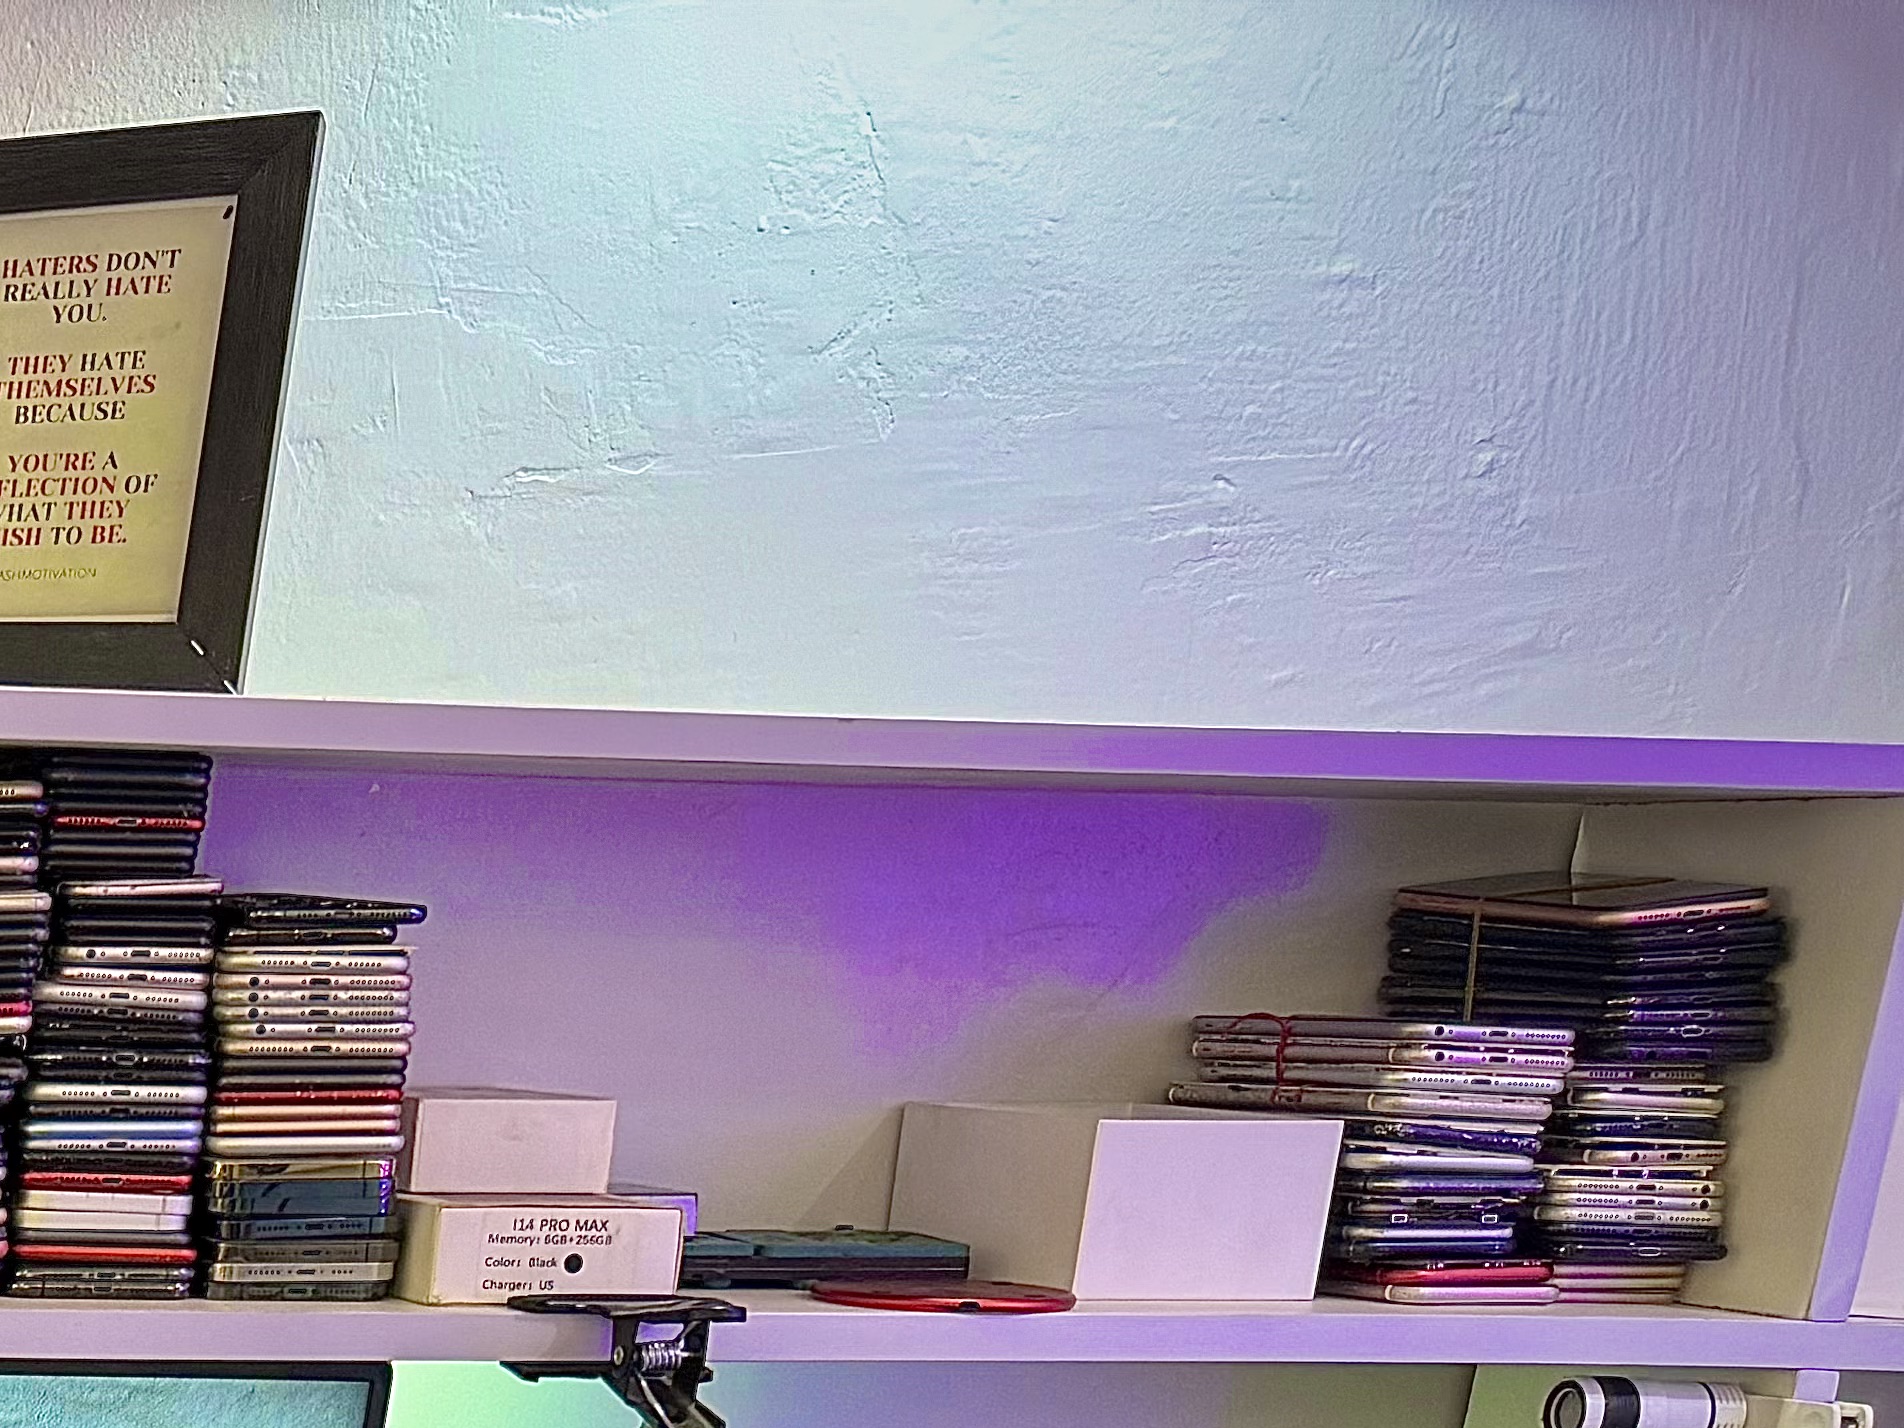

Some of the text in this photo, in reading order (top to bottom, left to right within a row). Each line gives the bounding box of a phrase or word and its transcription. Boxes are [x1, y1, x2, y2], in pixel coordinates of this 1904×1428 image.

[2, 248, 182, 279] HATERS DON'T
[3, 274, 173, 302] REALLY HATE
[52, 302, 108, 324] YOU.
[8, 350, 147, 376] THEY HATE
[14, 400, 127, 425] BECAUSE
[8, 451, 119, 474] YOU'RE A
[124, 473, 159, 494] OF
[64, 499, 131, 521] THEY
[50, 526, 84, 546] TO
[90, 523, 128, 545] BE.
[540, 1219, 569, 1231] PRO
[574, 1219, 609, 1231] MAX
[488, 1234, 540, 1246] Memory:
[485, 1257, 520, 1268] Color:
[482, 1279, 554, 1291] Charger: US
